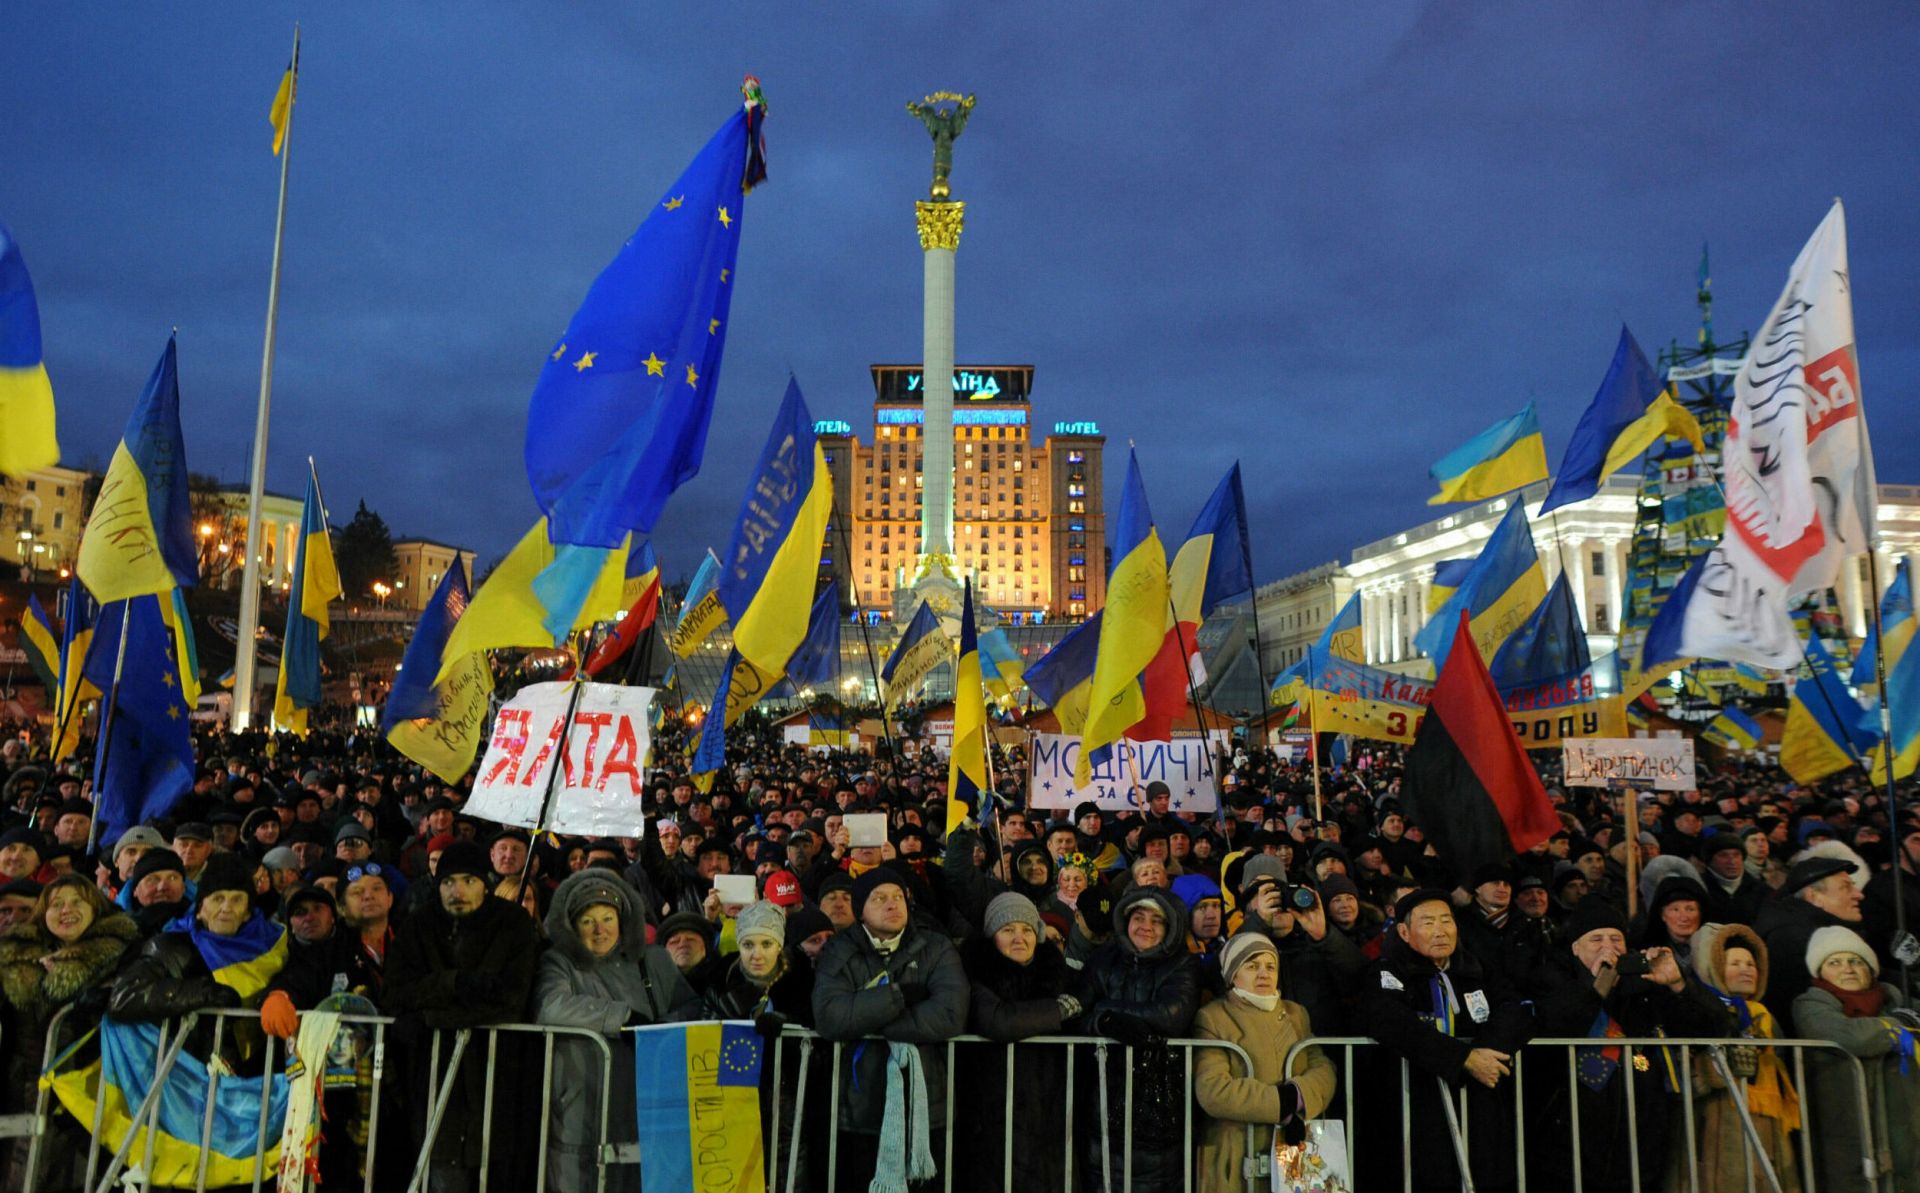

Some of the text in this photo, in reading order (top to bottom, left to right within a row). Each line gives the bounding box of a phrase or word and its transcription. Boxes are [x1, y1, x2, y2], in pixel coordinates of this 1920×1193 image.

[1055, 421, 1100, 434] HOTEL
[481, 709, 643, 796] ЯЛТА
[1097, 785, 1116, 798] ЗА
